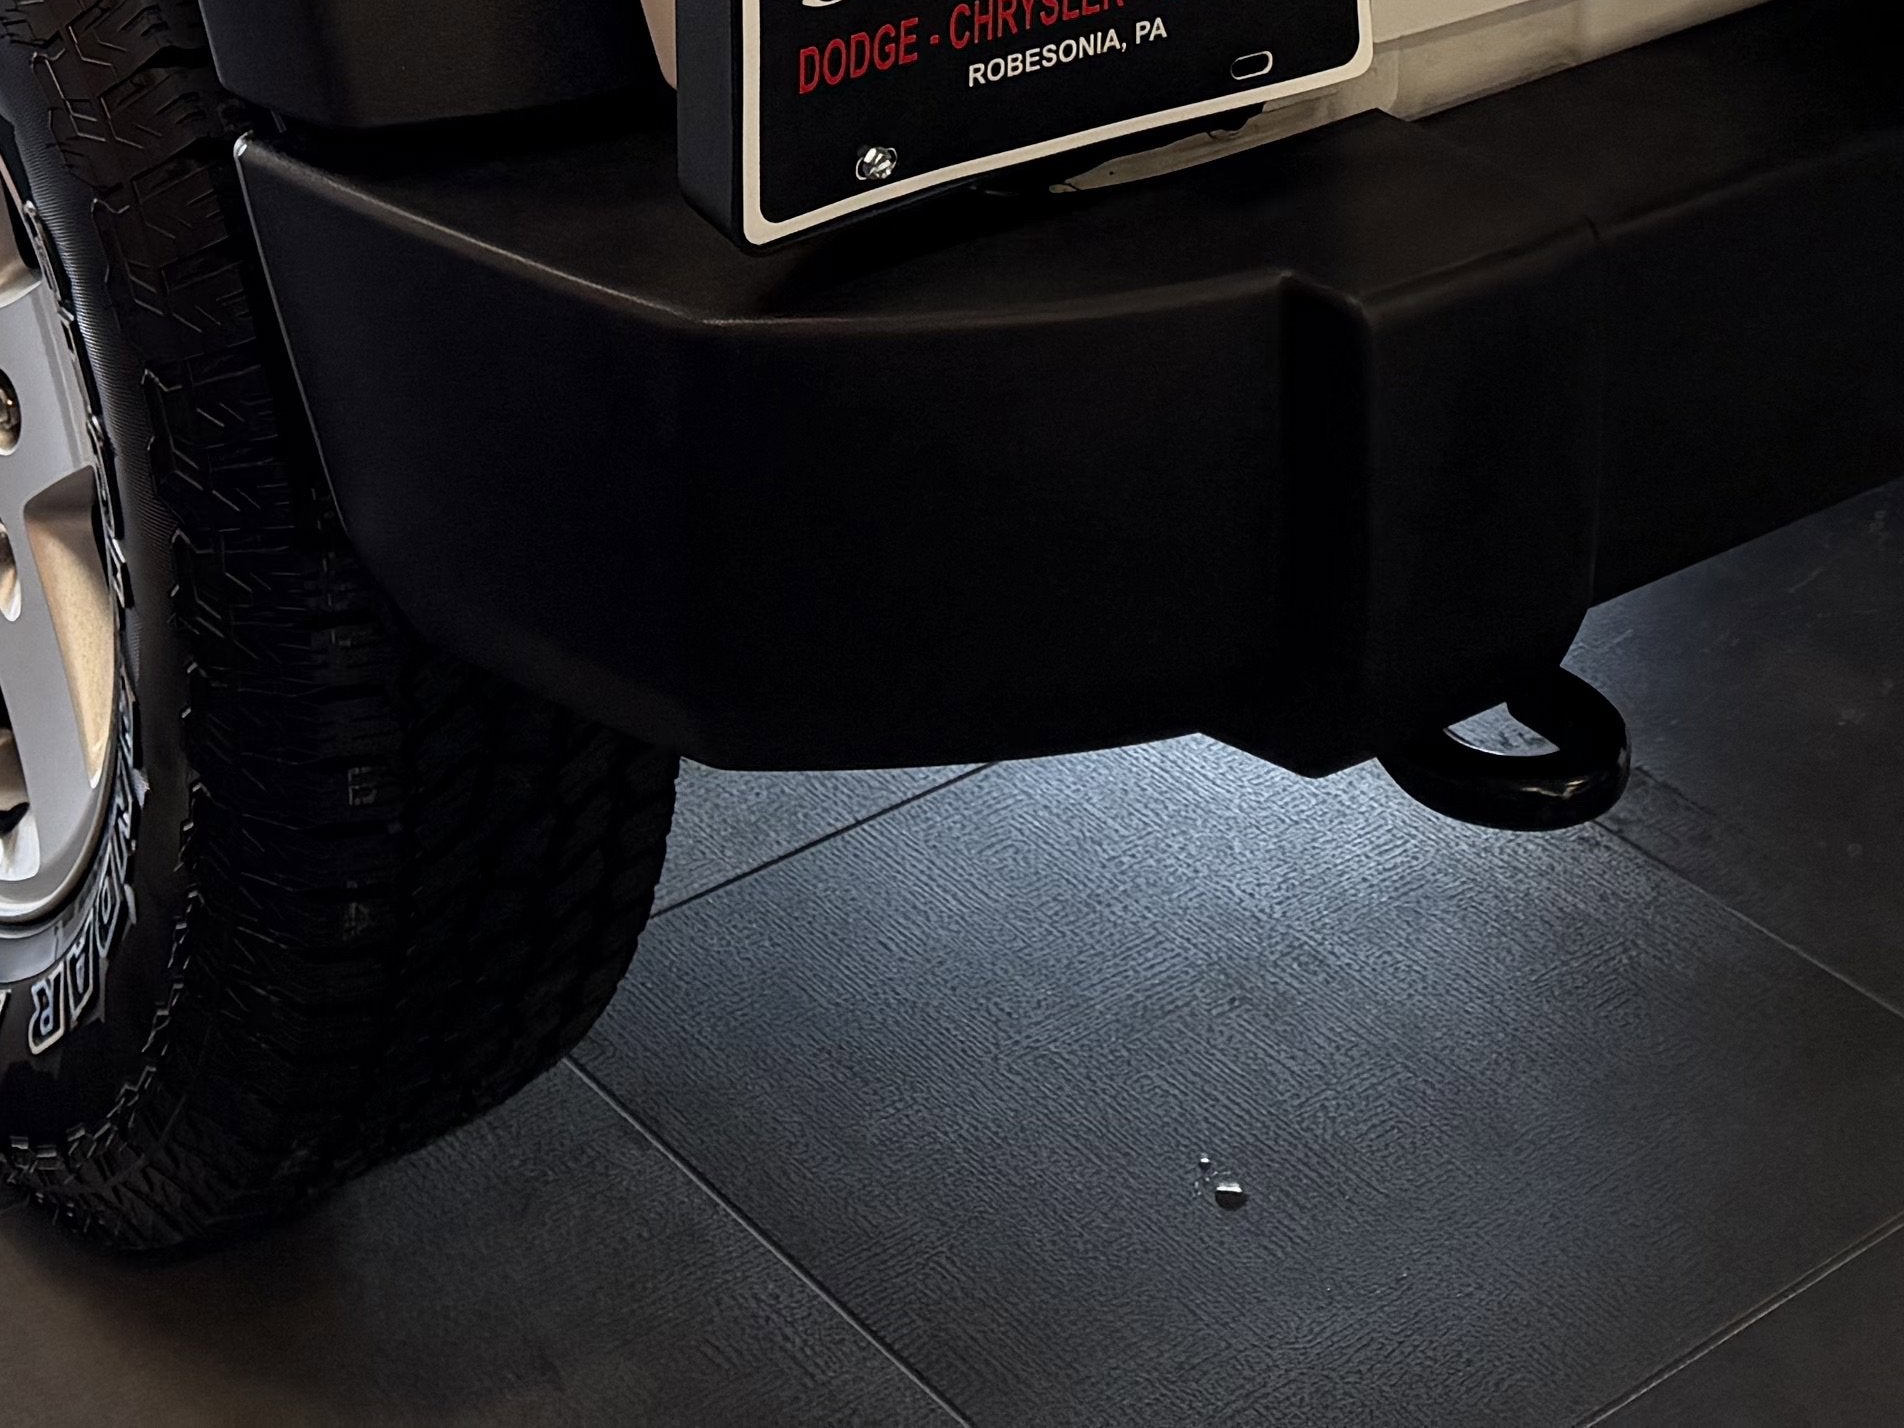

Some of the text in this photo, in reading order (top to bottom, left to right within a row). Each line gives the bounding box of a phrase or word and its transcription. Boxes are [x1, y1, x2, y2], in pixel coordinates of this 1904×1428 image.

[799, 17, 919, 94] DODGE
[968, 17, 1167, 87] ROBESONIA, PA
